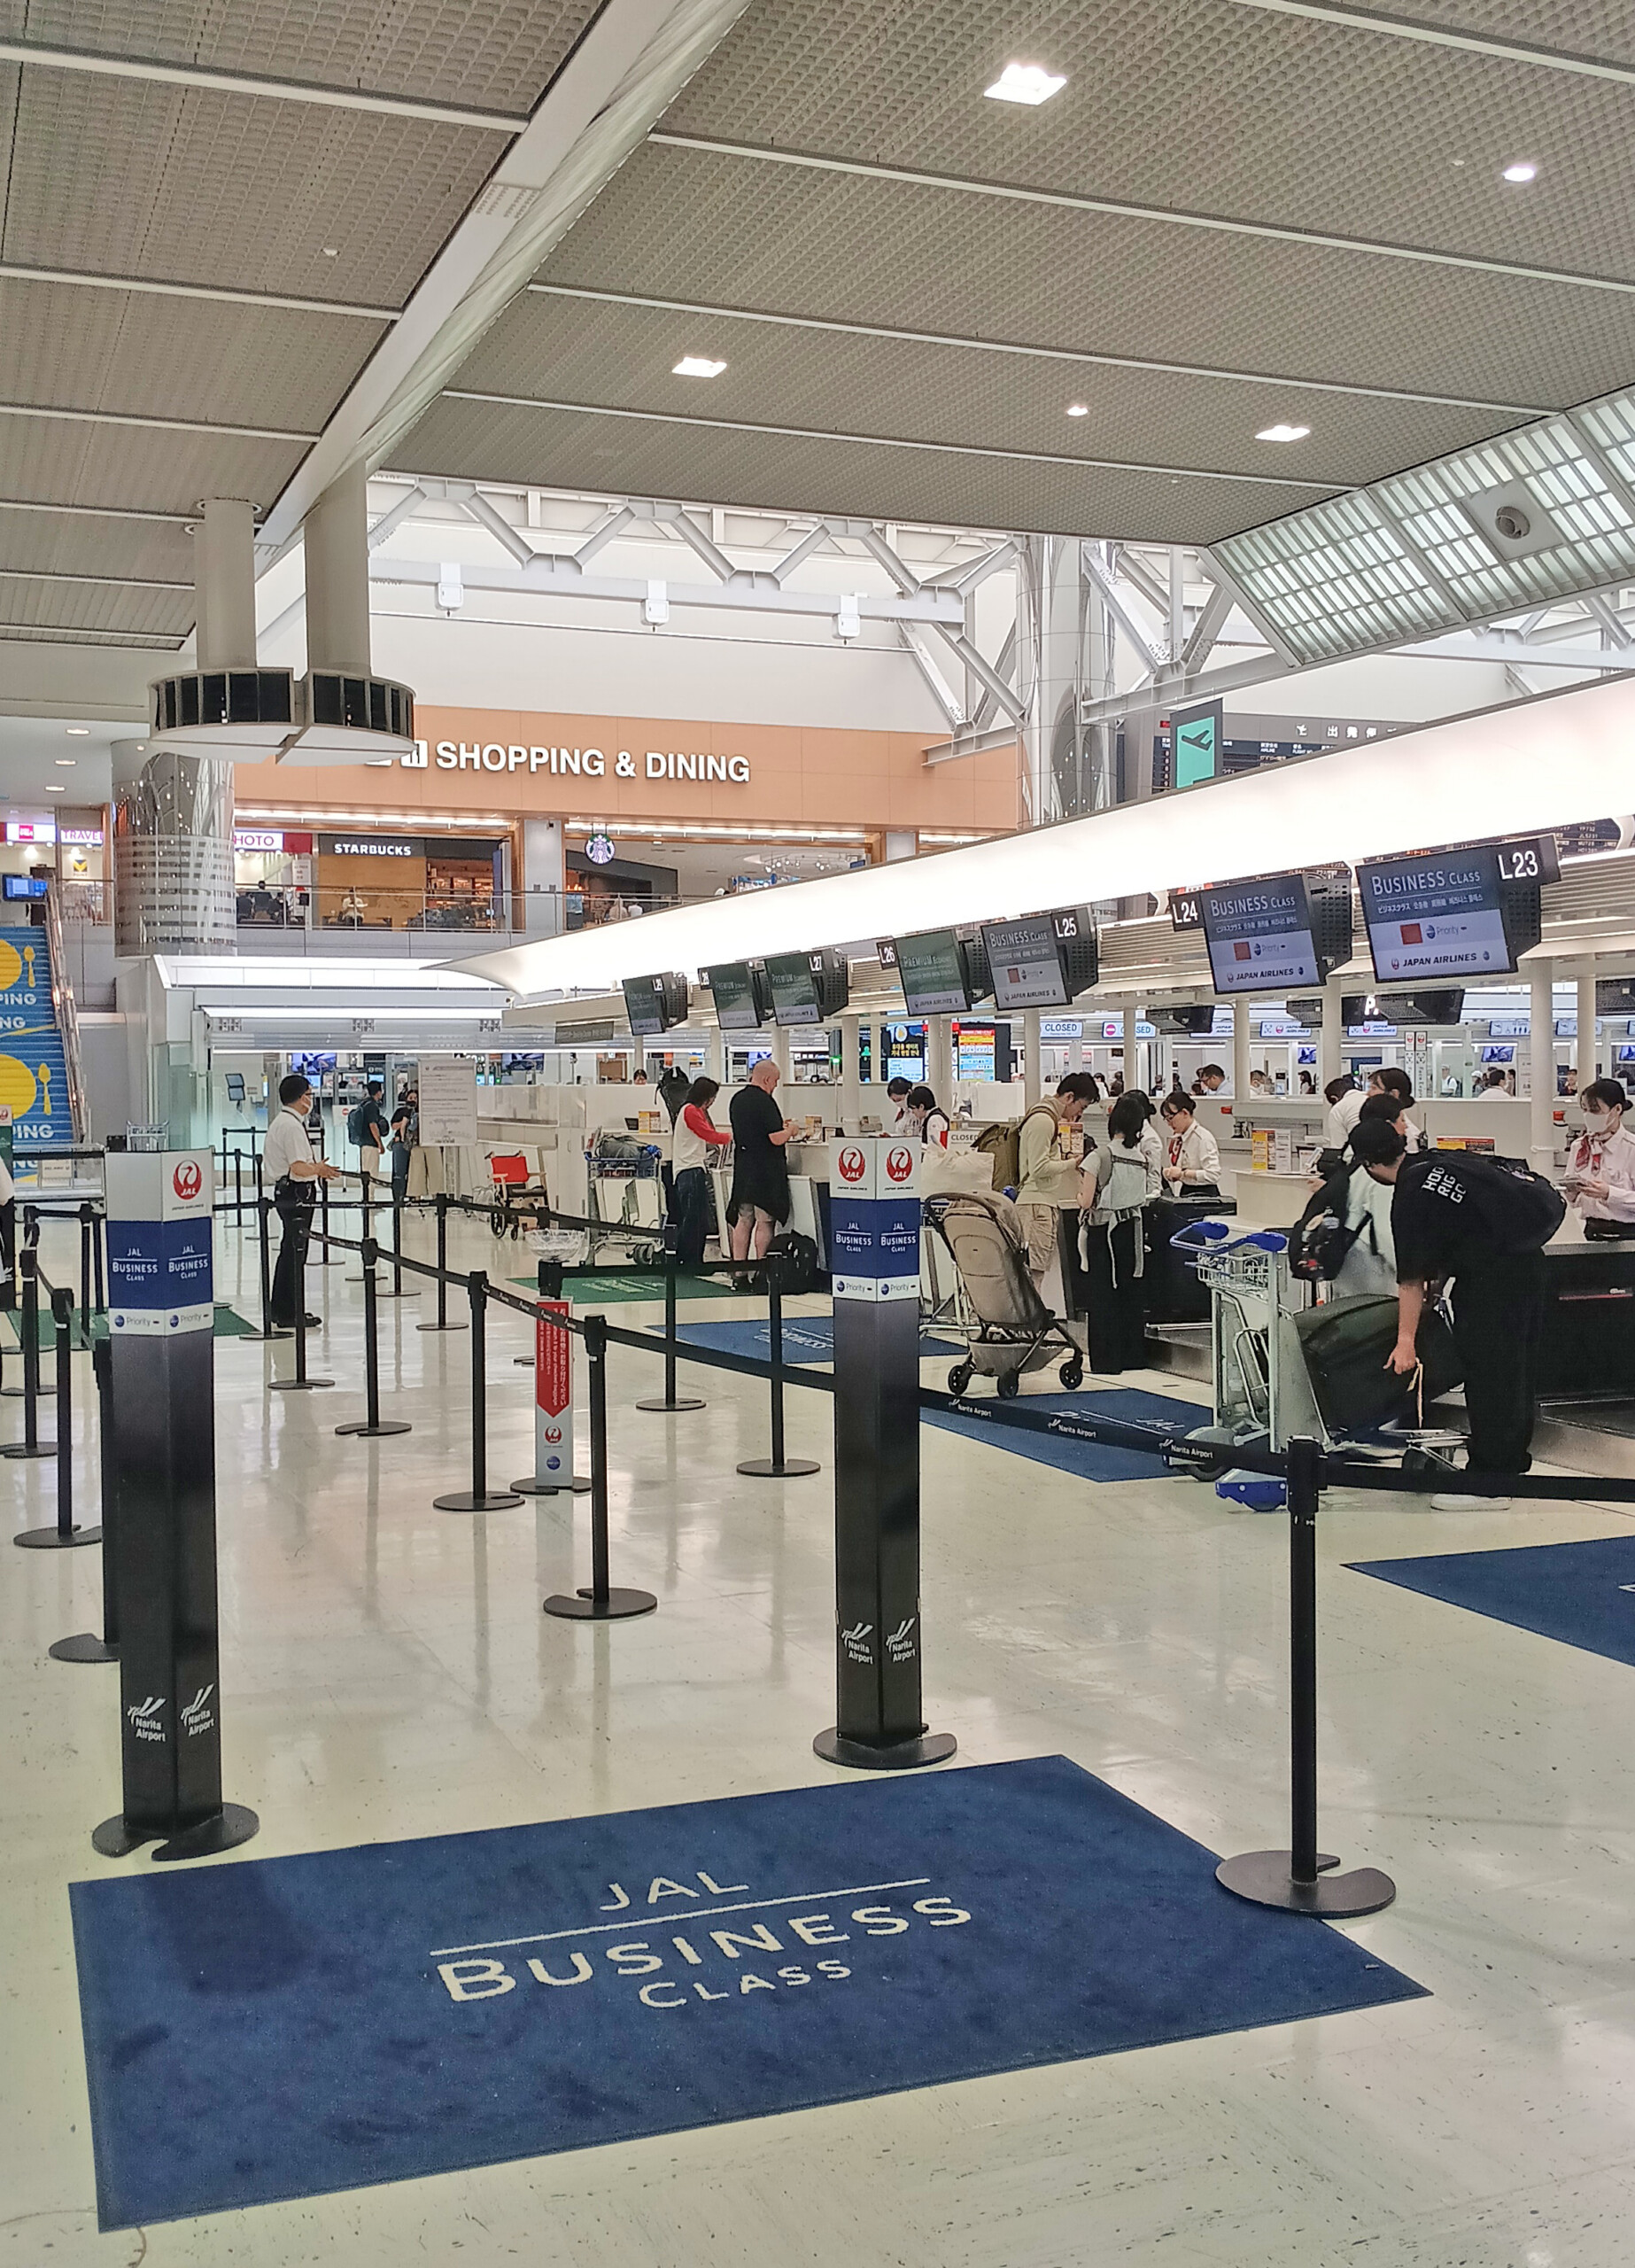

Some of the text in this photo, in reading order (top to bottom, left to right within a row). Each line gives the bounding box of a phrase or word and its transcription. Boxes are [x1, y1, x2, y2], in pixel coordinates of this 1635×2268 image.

[435, 741, 751, 782] SHOPPING & DINING
[234, 835, 275, 846] HOTO
[334, 843, 412, 856] STARBUCKS
[1498, 850, 1538, 880] L23
[1372, 871, 1481, 896] BUSINESS CLASS
[1172, 900, 1197, 923] L24
[1210, 896, 1296, 917] BUSINESS CLASS
[1055, 917, 1077, 938] L25
[989, 930, 1048, 947] BUSINESS CLASS
[879, 947, 895, 964] L26
[903, 955, 933, 967] PREMIUM
[1403, 953, 1477, 967] JAPAN AIRLINES
[809, 956, 822, 971] L27
[1236, 968, 1294, 981] JAPAN AIRLINES
[1045, 1023, 1077, 1032] CLOSED
[181, 1187, 197, 1196] JAL
[1437, 1175, 1456, 1197] RIG
[836, 1234, 872, 1246] BUSINESS
[880, 1235, 916, 1246] BUSINESS
[182, 1245, 195, 1254] JAL
[112, 1262, 159, 1273] BUSINESS
[168, 1259, 208, 1272] BUSINESS
[846, 1282, 865, 1293] Priority
[890, 1281, 909, 1293] Priority
[127, 1316, 151, 1326] Priority
[181, 1312, 202, 1323] Priority
[973, 1407, 992, 1418] Airport
[1058, 1425, 1096, 1439] Narita Airport
[1171, 1444, 1213, 1459] Narita Airport
[848, 1640, 870, 1653] Narita
[892, 1641, 912, 1652] Narita
[848, 1650, 873, 1665] Airport
[893, 1648, 916, 1662] Airport
[136, 1718, 161, 1730] Narita
[189, 1710, 211, 1726] Narita
[189, 1719, 214, 1736] Airport
[136, 1728, 166, 1742] Airport
[600, 1871, 749, 1912] JAL
[437, 1897, 972, 2002] BUSINESS
[639, 1959, 852, 2008] CLASS
